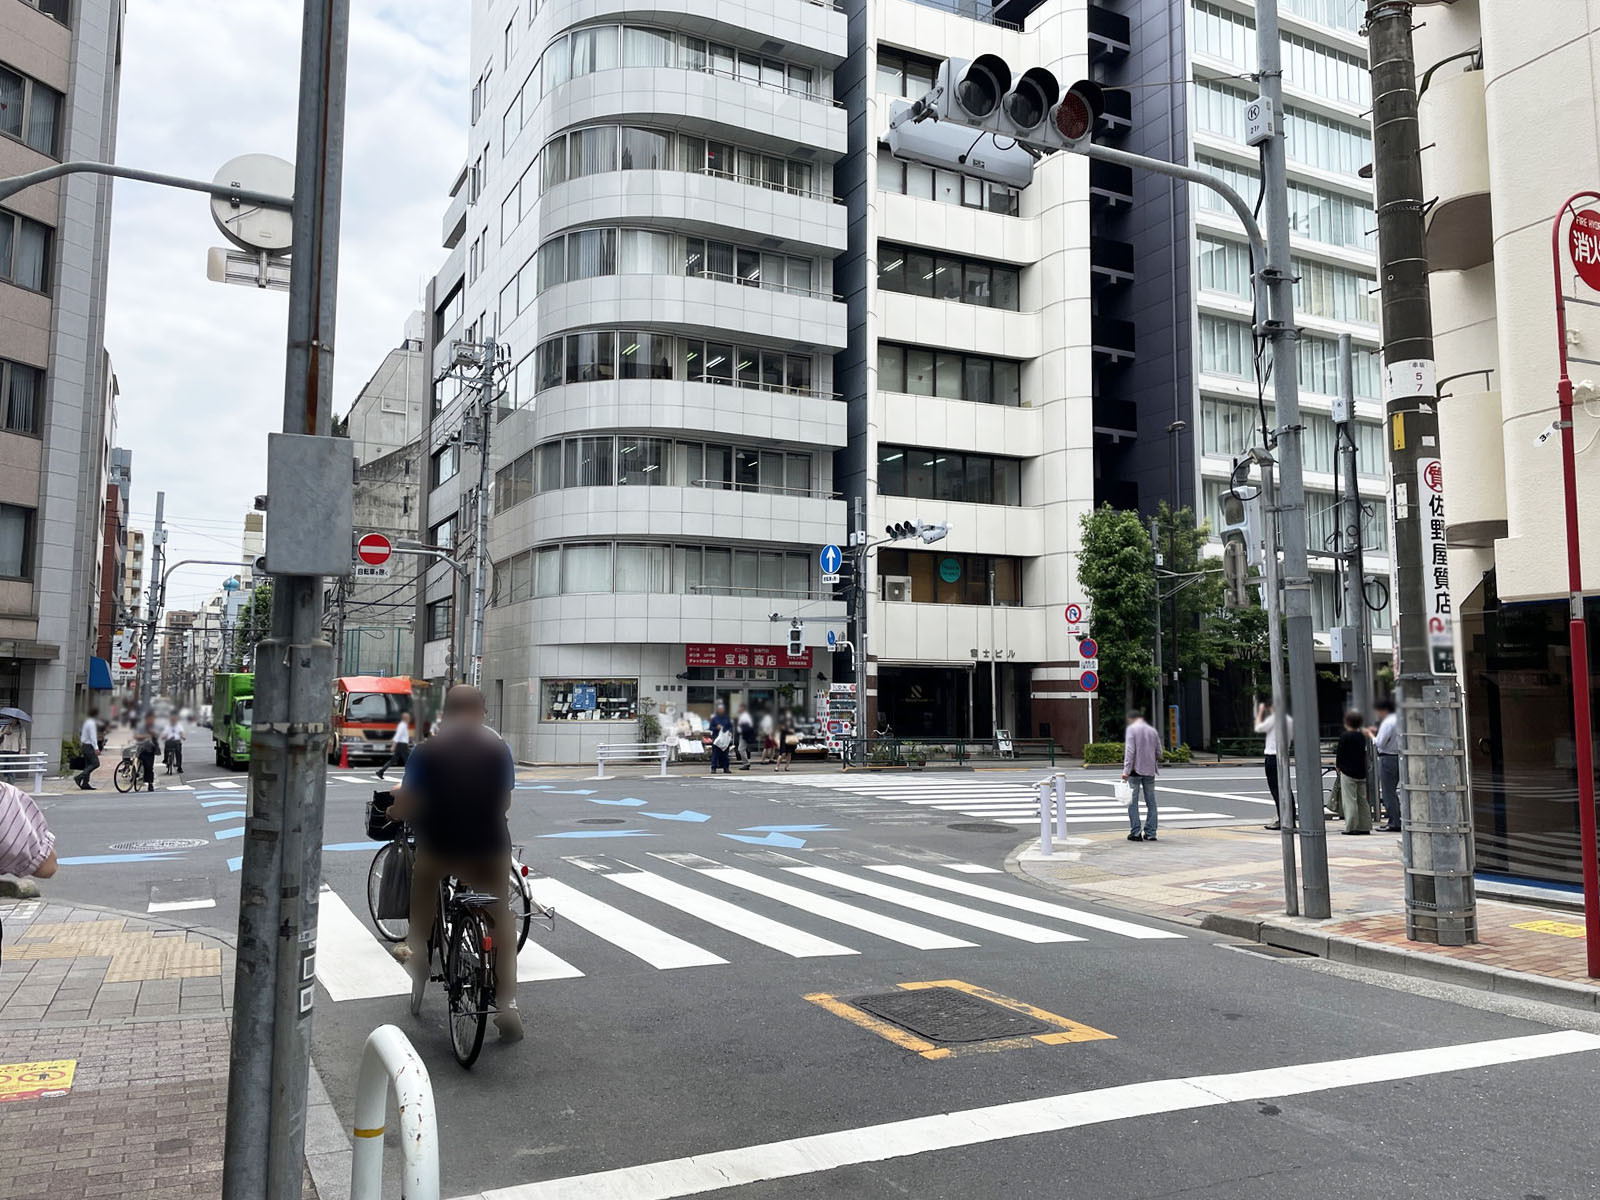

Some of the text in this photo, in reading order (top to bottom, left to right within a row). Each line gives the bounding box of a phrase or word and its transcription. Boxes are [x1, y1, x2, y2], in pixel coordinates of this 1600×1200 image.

[1575, 215, 1588, 228] FIRE
[725, 653, 777, 667] 宮地商店
